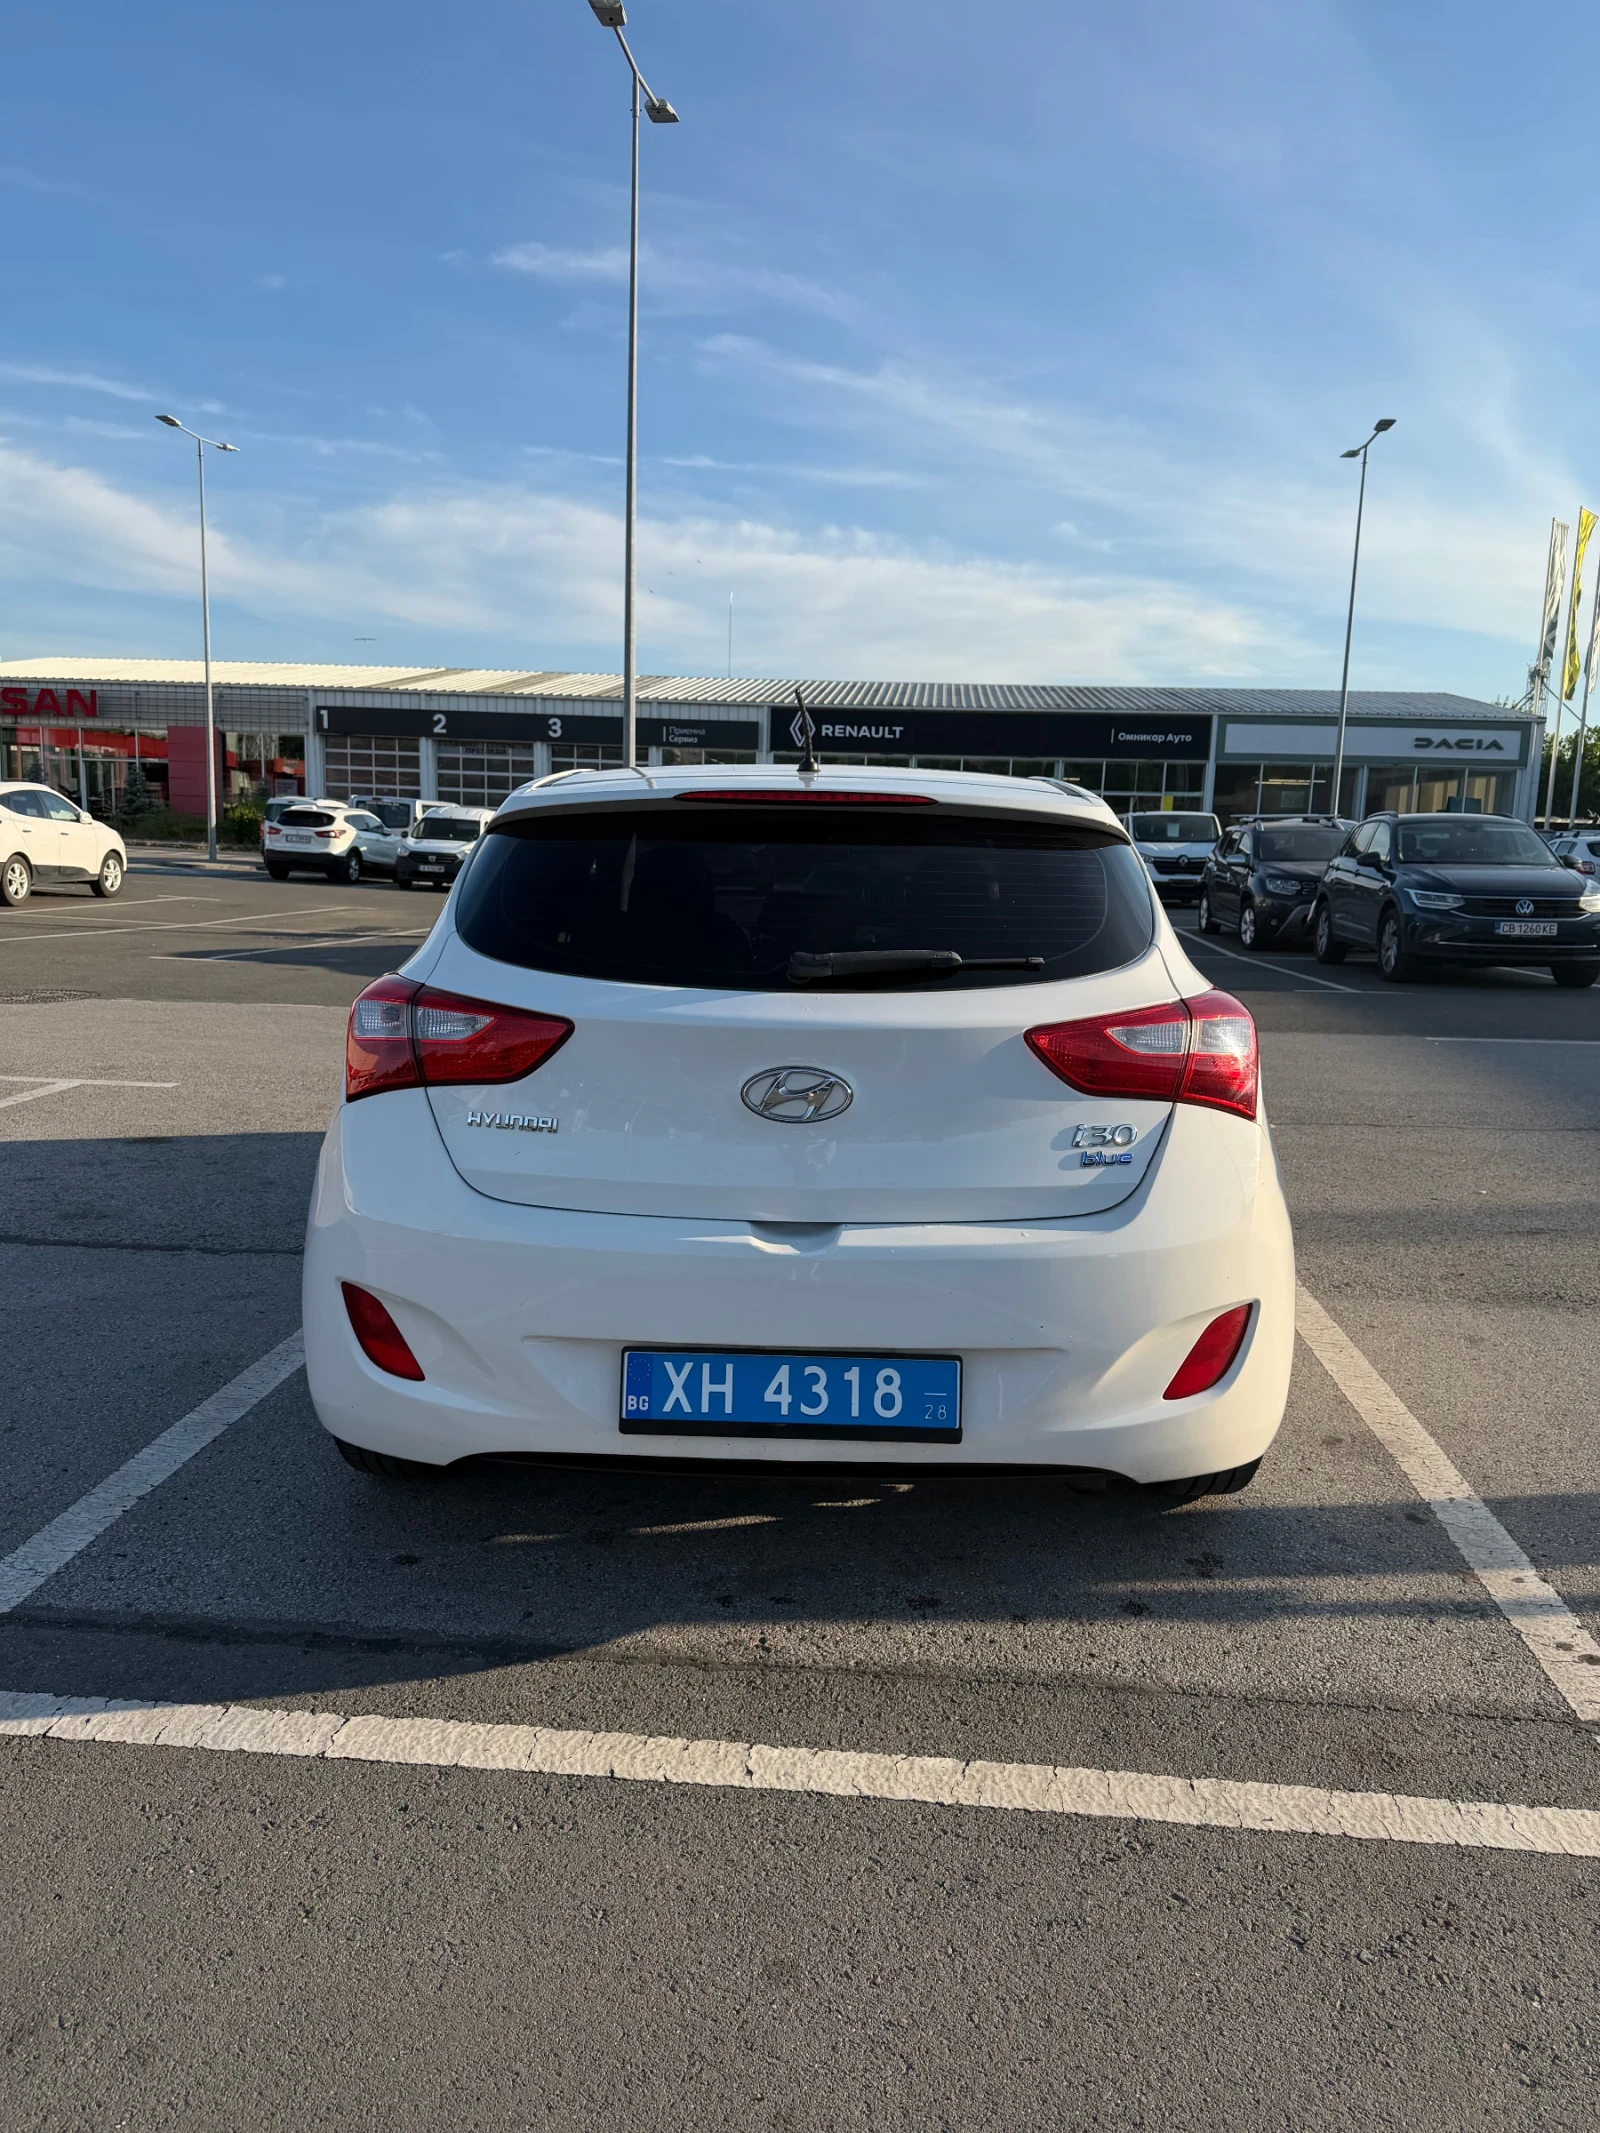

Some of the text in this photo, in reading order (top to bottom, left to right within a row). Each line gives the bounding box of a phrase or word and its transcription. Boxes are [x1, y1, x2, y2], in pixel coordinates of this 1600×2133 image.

[320, 710, 329, 729] 1
[433, 713, 447, 733] 2
[548, 717, 562, 738] 3
[669, 735, 698, 744] Сервиз
[821, 724, 904, 739] RENAULT
[1118, 732, 1192, 744] Омникар Ауто
[1414, 737, 1504, 751] DACIA
[1502, 923, 1556, 935] CB 1260 KE
[467, 1111, 559, 1134] HYUNDAI
[1072, 1124, 1138, 1147] i30
[1081, 1151, 1134, 1167] blue
[662, 1361, 903, 1419] XH 4318
[627, 1395, 649, 1410] BG
[924, 1404, 947, 1420] 28
